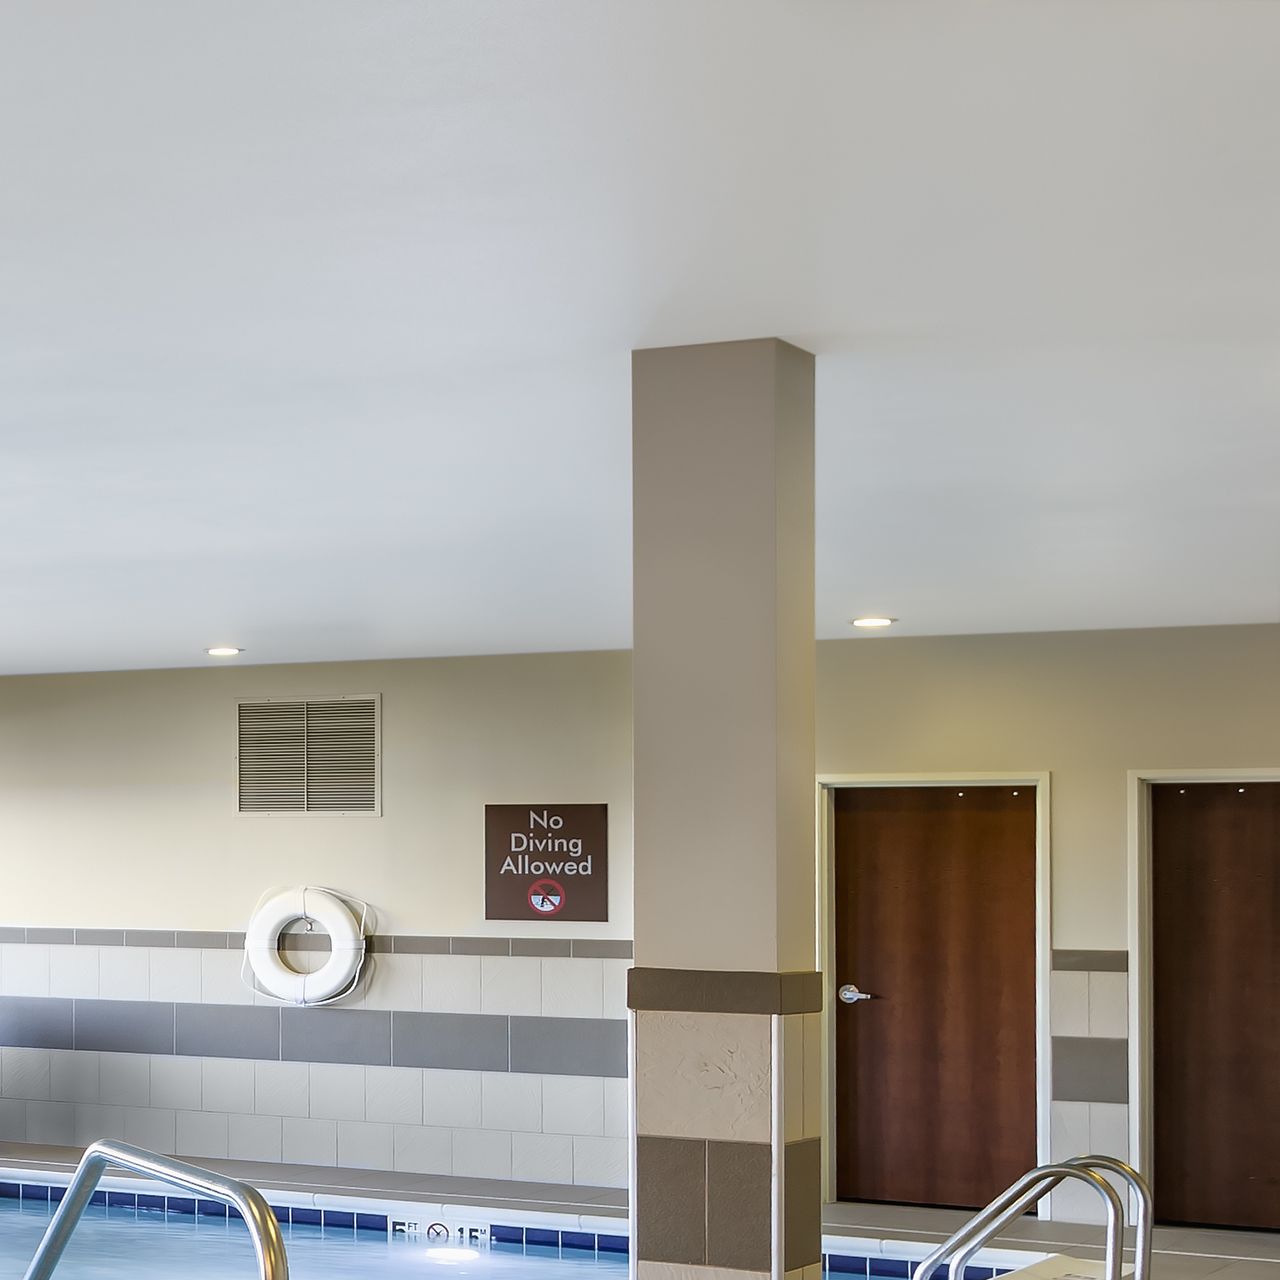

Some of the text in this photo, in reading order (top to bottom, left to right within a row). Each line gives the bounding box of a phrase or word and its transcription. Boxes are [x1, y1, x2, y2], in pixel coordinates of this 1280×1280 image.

[529, 810, 564, 829] No
[510, 832, 582, 857] Diving
[500, 854, 592, 875] Allowed
